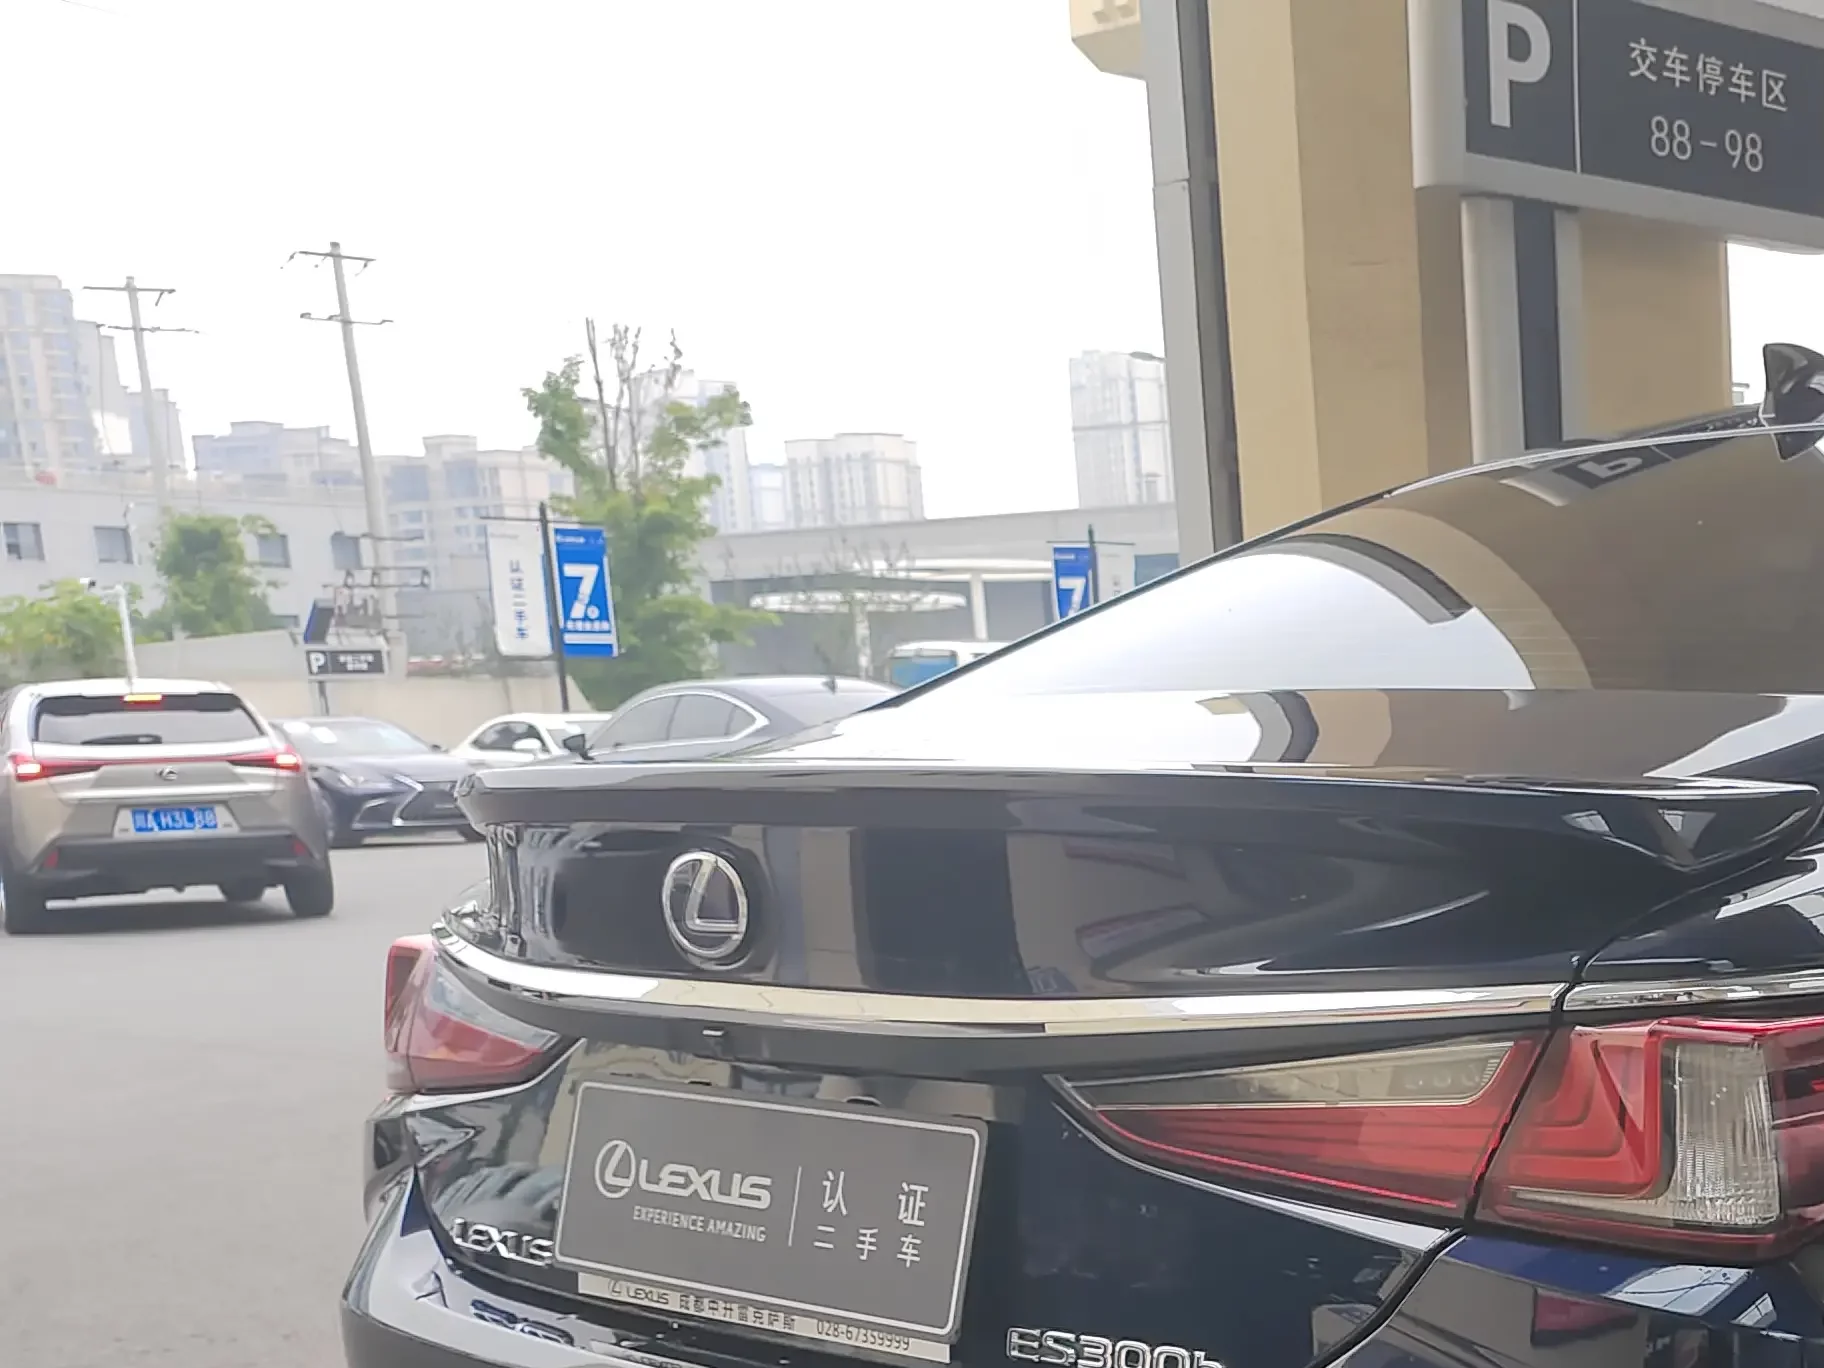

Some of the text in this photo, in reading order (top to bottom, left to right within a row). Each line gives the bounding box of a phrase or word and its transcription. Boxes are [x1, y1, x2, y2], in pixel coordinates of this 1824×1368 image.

[1486, 0, 1552, 128] P
[1628, 37, 1788, 112] 交车停车区
[1650, 115, 1764, 173] 88-98
[639, 1158, 773, 1210] LEXUS
[632, 1205, 767, 1243] EXPERIENCE AMAZING
[626, 1287, 670, 1305] LEXUS
[816, 1319, 910, 1351] 028-67359999
